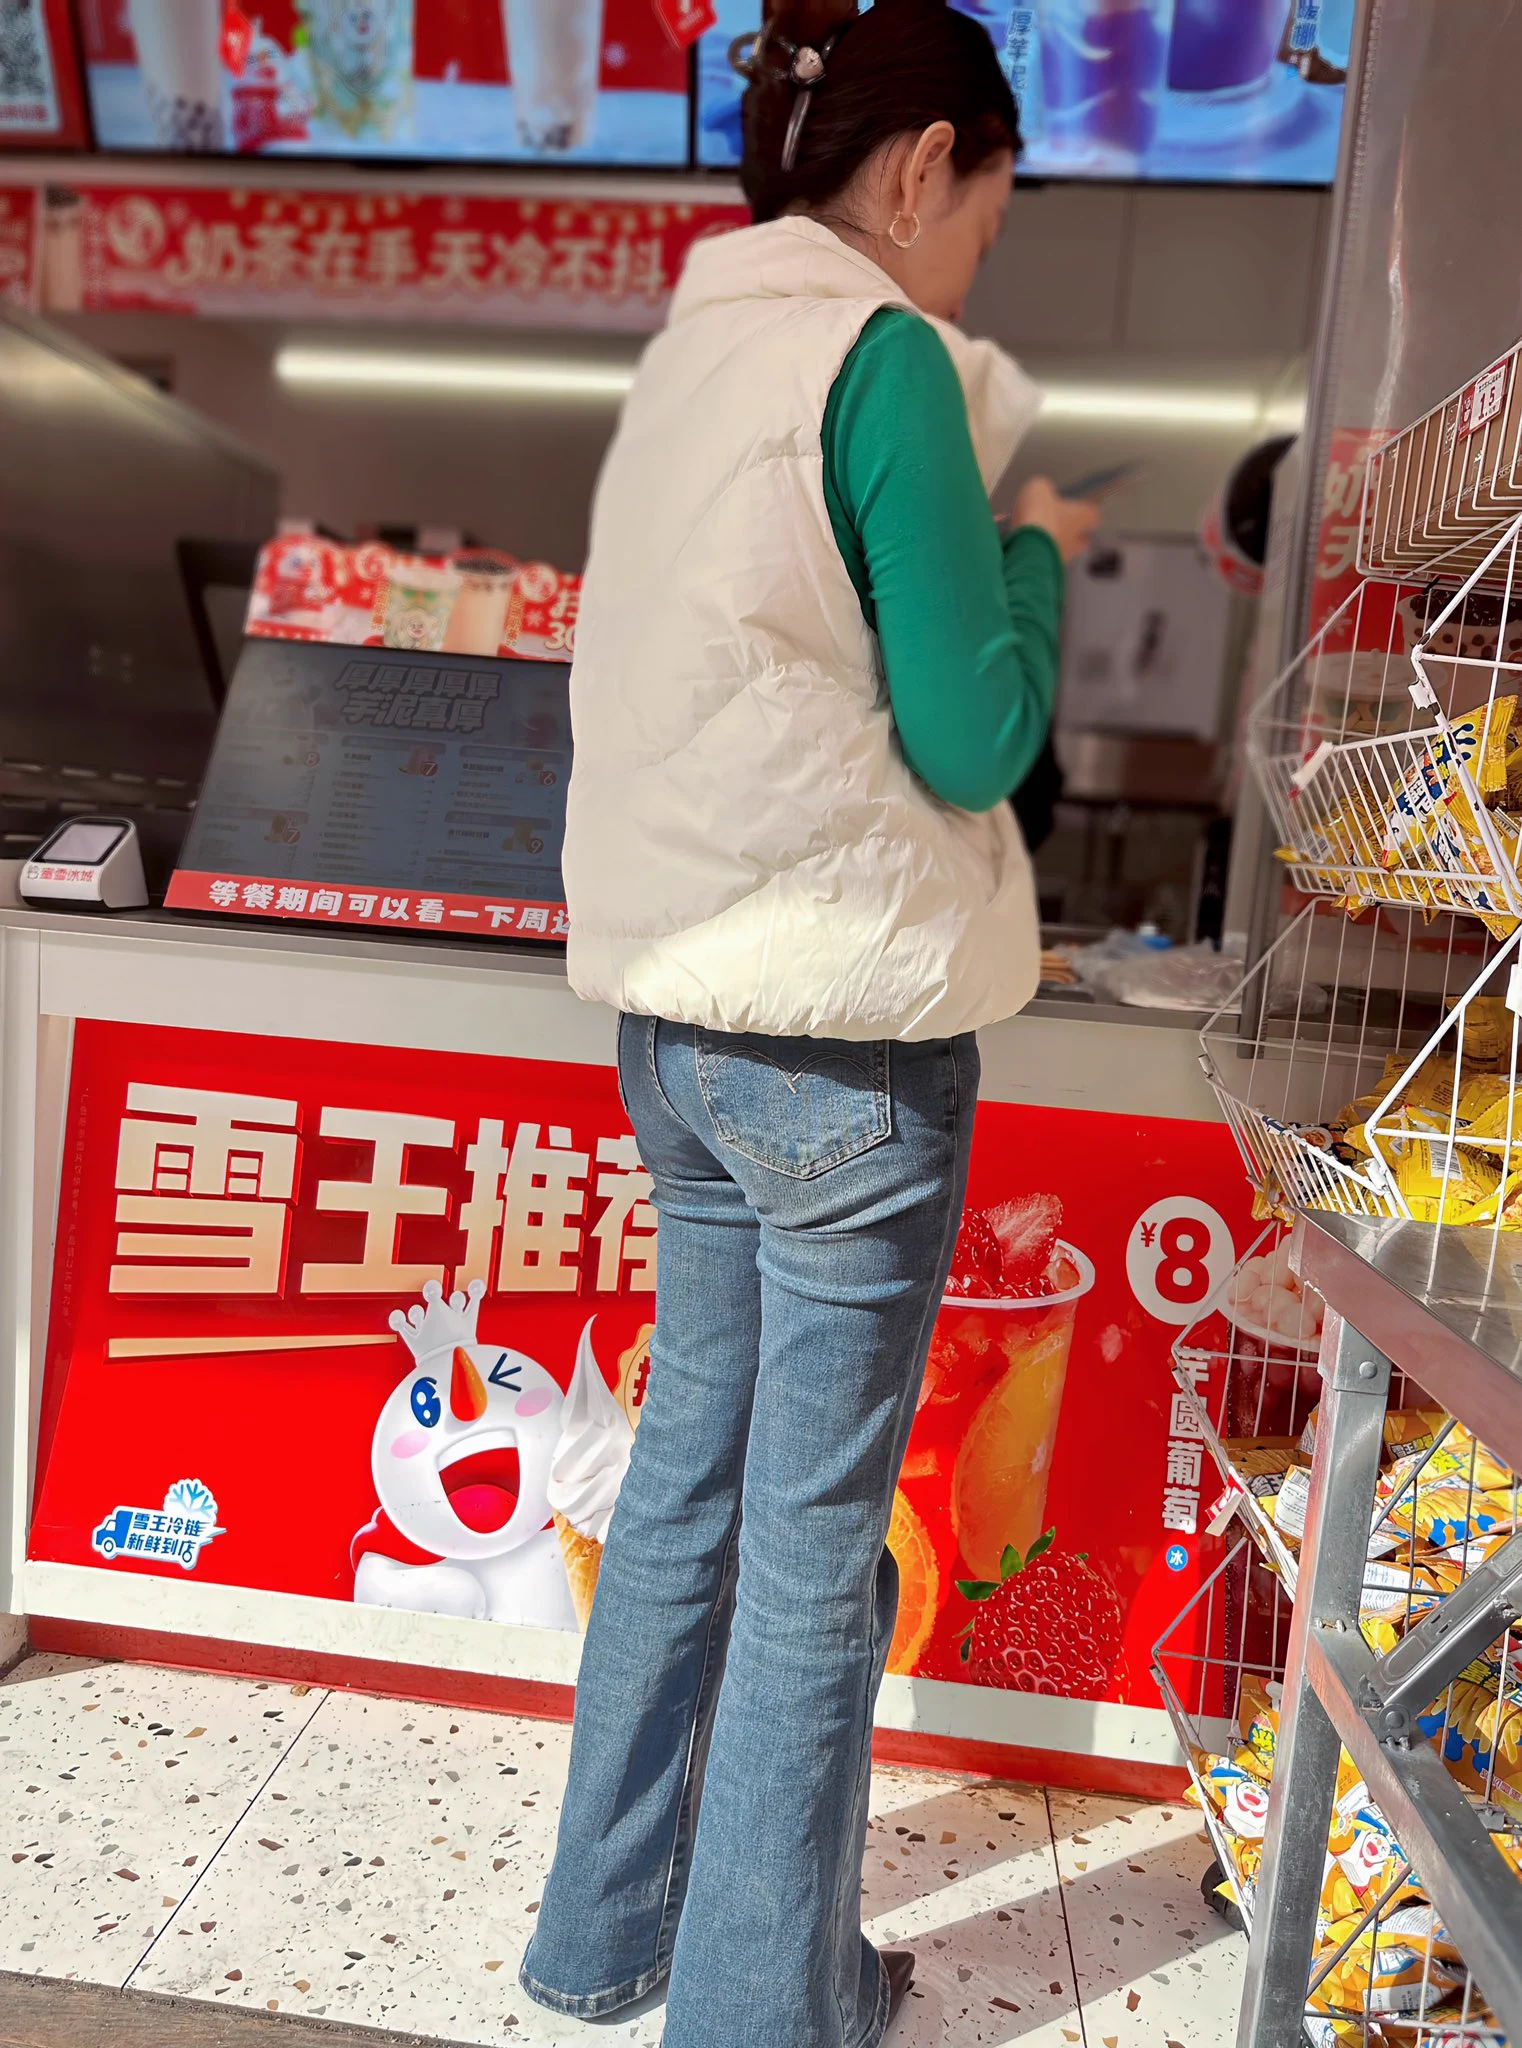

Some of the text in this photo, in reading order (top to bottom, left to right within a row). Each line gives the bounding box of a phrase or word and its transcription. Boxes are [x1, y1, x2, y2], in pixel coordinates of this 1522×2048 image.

[132, 1512, 201, 1537] 雪王冷链
[127, 1532, 197, 1563] 新鲜到店
[1168, 1550, 1185, 1567] 冰
